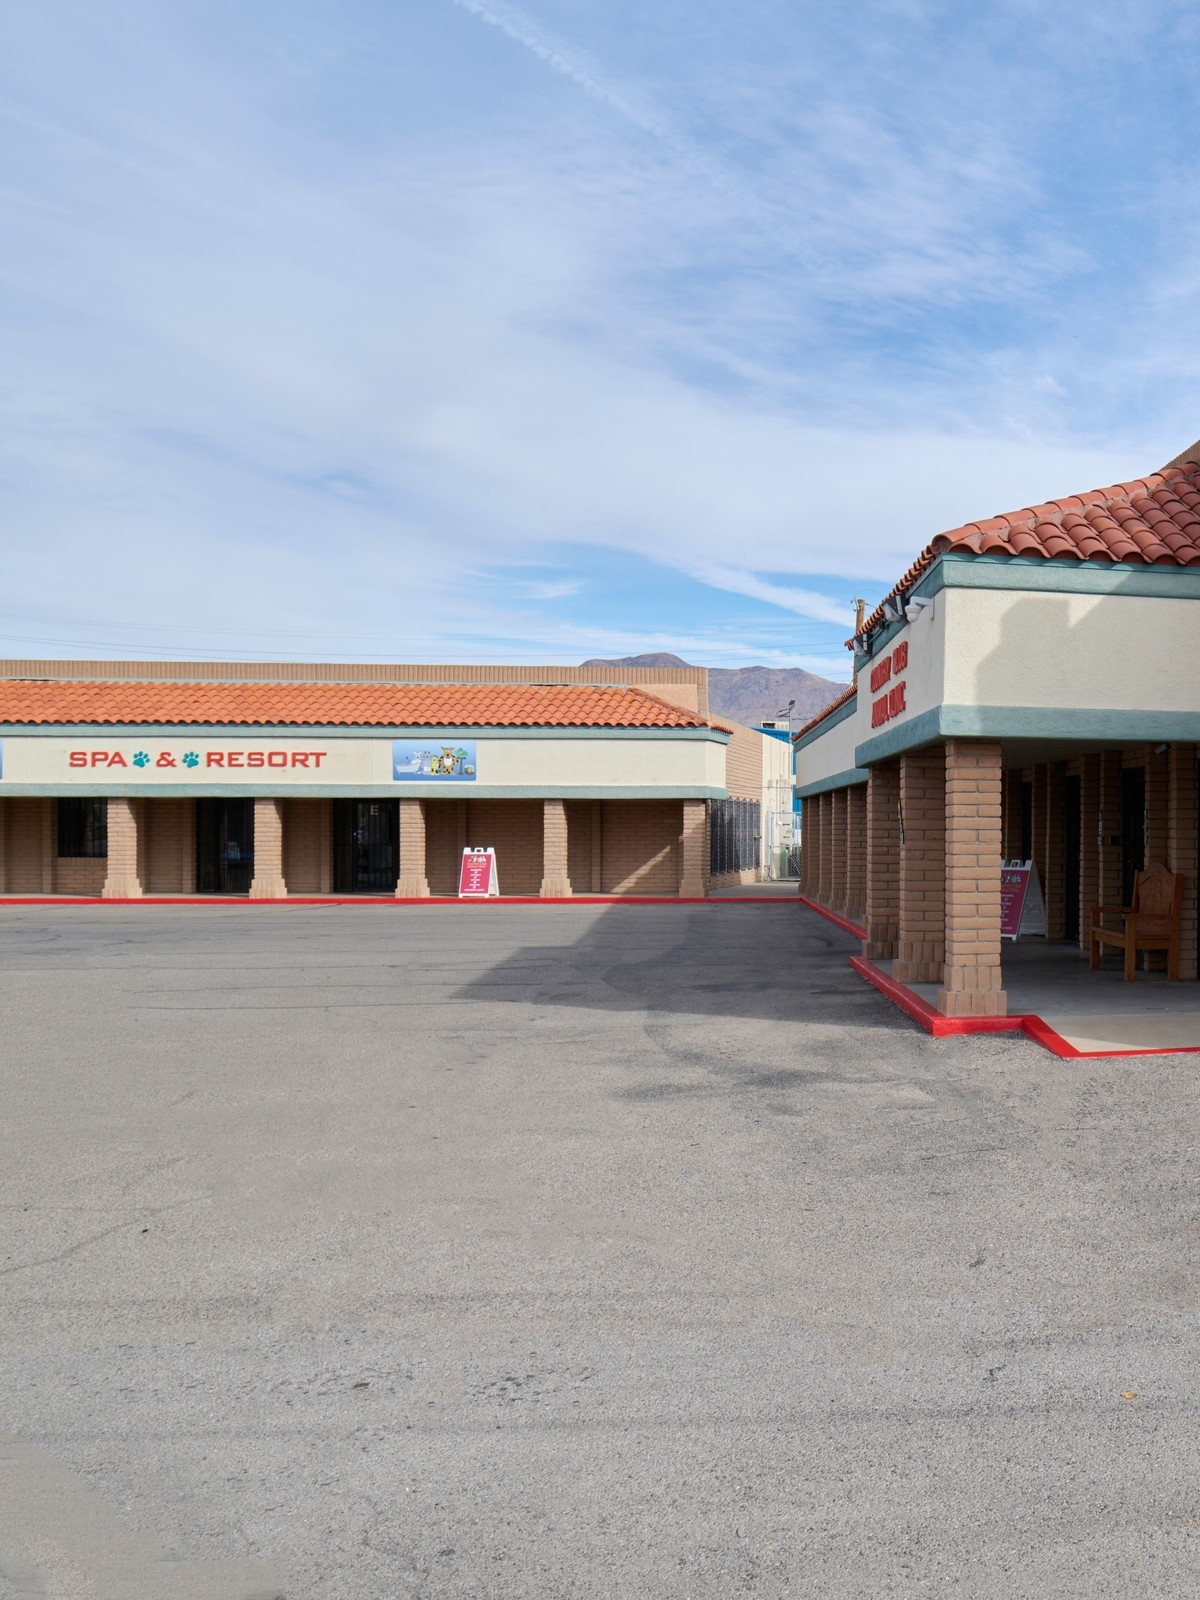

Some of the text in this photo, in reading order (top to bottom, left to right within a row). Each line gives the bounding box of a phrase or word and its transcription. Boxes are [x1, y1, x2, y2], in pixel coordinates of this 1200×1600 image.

[69, 751, 327, 768] SPA & RESORT
